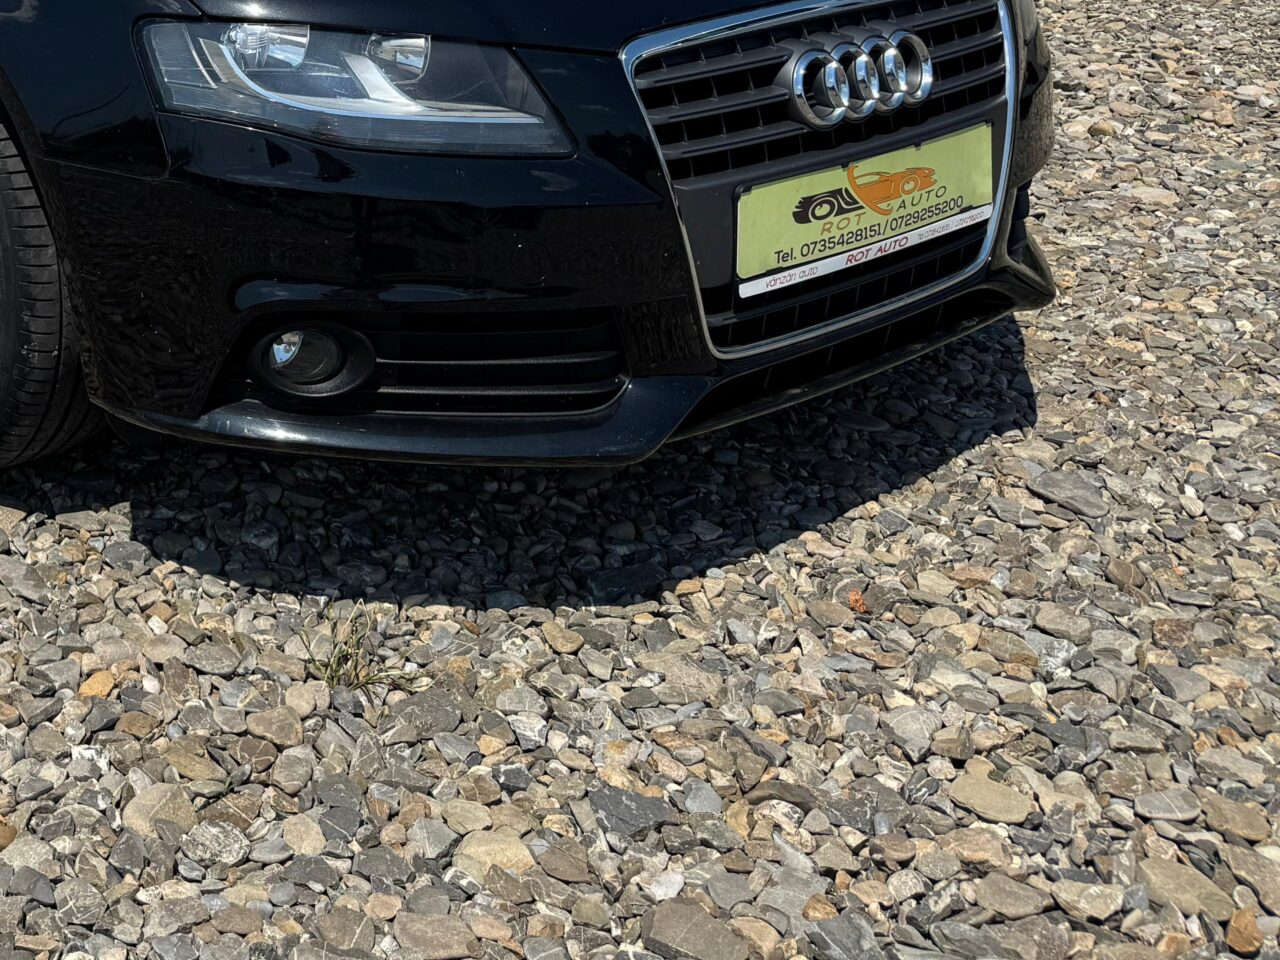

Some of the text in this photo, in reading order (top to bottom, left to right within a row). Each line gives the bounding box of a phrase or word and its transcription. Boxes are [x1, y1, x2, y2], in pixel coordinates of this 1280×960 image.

[775, 195, 963, 264] Tel. 0735428151/0729255200
[821, 185, 947, 235] ROT AUTO
[798, 266, 818, 279] auto
[845, 248, 872, 265] ROT
[875, 237, 909, 256] AUTO
